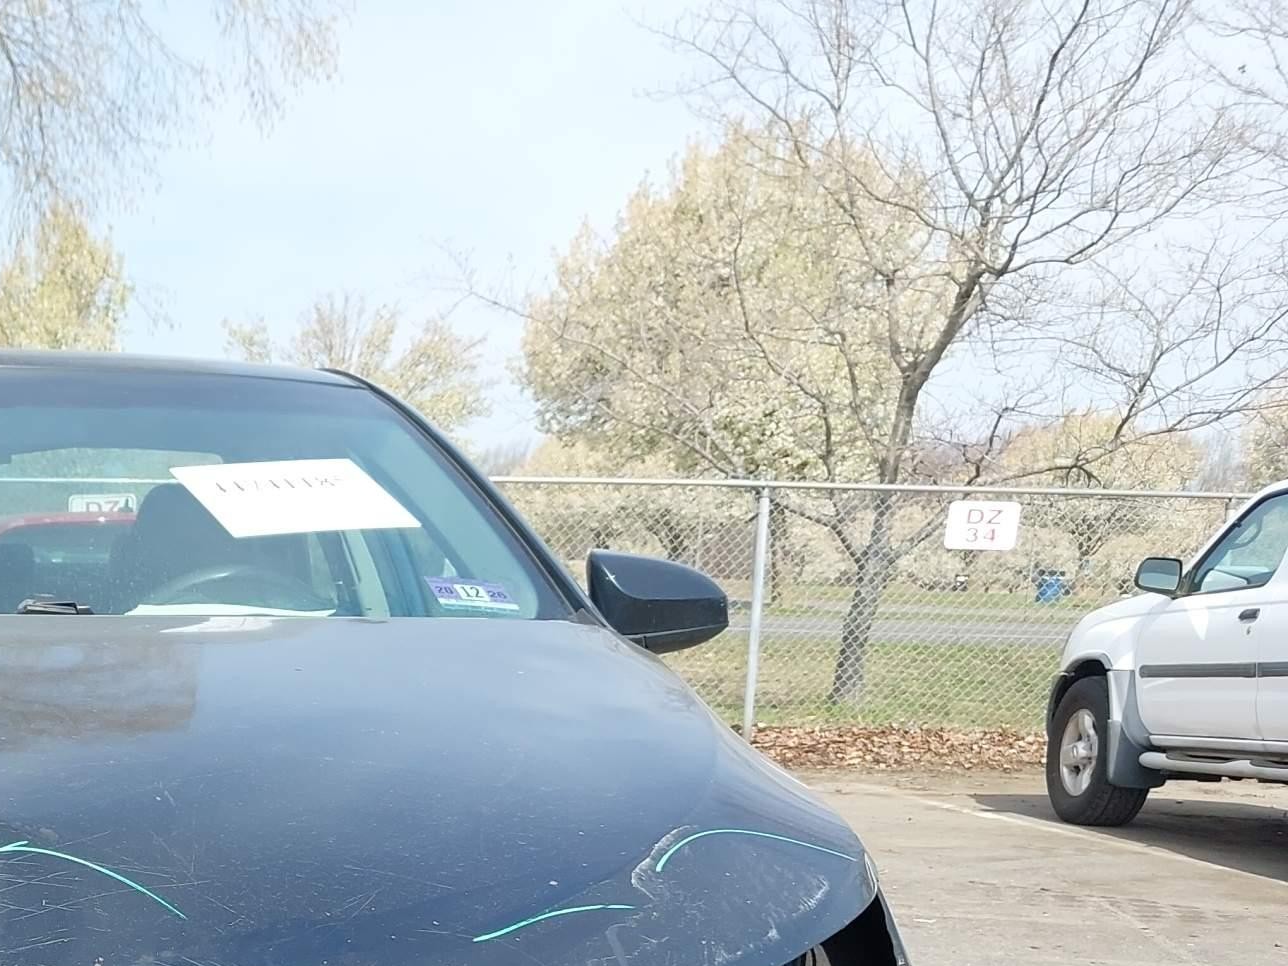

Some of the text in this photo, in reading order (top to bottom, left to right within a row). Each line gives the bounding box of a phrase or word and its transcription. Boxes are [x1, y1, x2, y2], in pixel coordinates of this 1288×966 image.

[966, 508, 1003, 525] DZ
[965, 527, 996, 543] 34
[460, 585, 484, 599] 12
